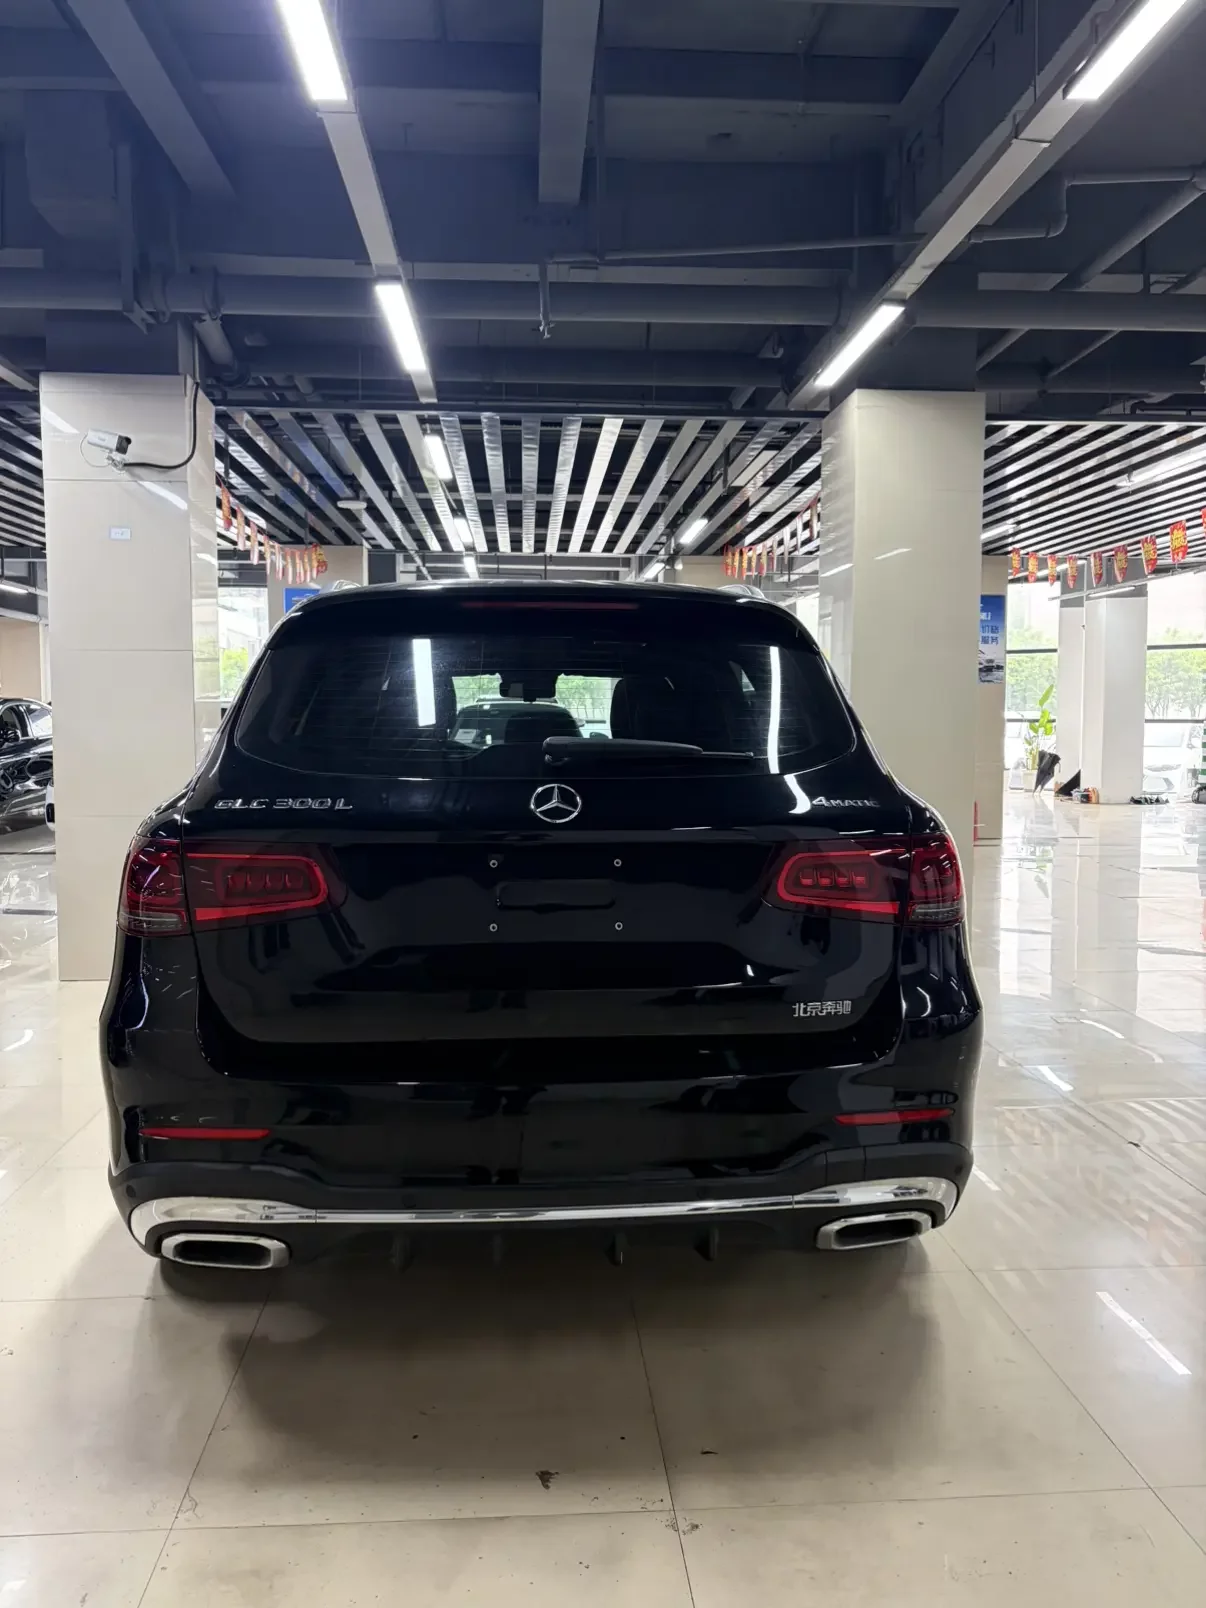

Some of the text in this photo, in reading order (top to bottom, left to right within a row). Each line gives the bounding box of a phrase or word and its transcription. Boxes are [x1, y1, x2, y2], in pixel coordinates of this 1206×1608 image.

[214, 798, 269, 809] GLC
[812, 796, 880, 808] 4MATIC
[792, 1000, 852, 1017] 北京奔驰
